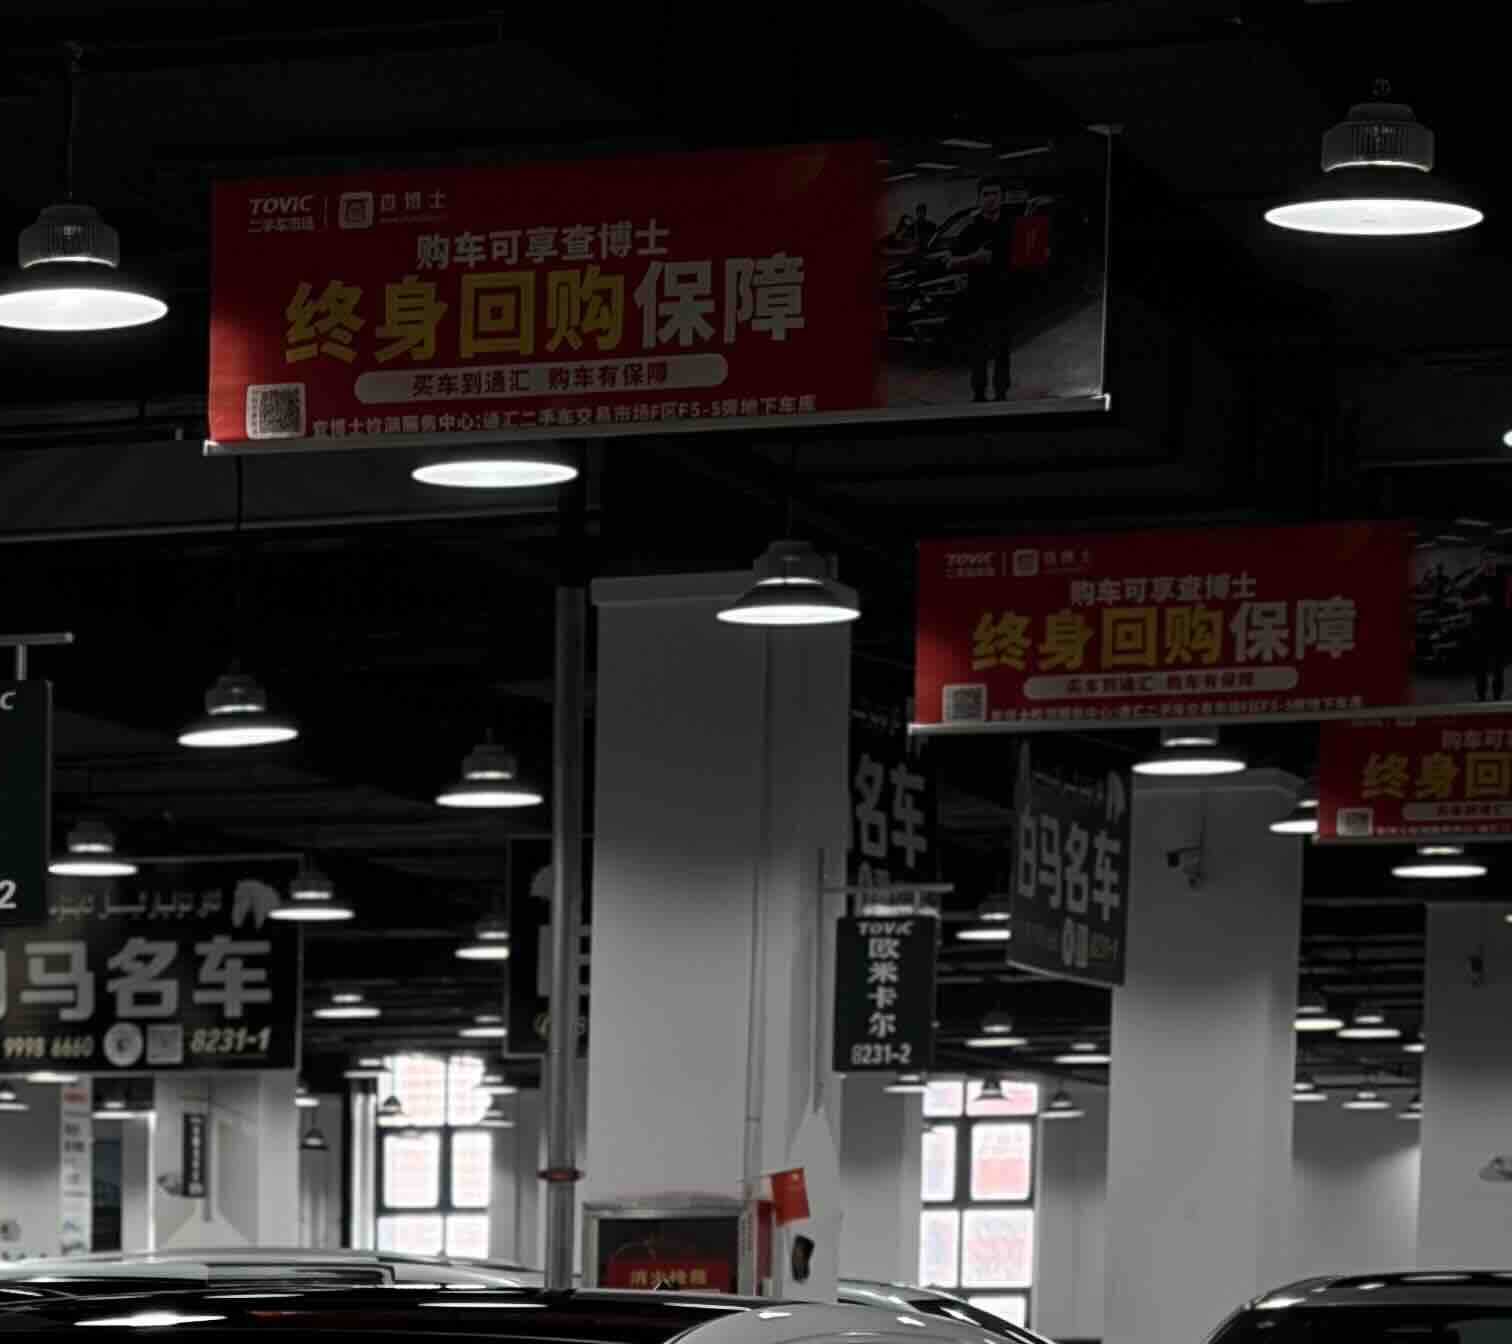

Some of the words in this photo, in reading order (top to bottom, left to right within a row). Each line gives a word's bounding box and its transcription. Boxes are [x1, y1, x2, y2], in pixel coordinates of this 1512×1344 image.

[249, 194, 314, 216] TOVIC
[417, 219, 670, 268] 购车可享查博士
[285, 252, 807, 364] 终身回购保障
[971, 596, 1357, 672] 终身回购保障
[190, 1026, 271, 1054] 8231-1
[849, 1041, 912, 1065] 8231-2
